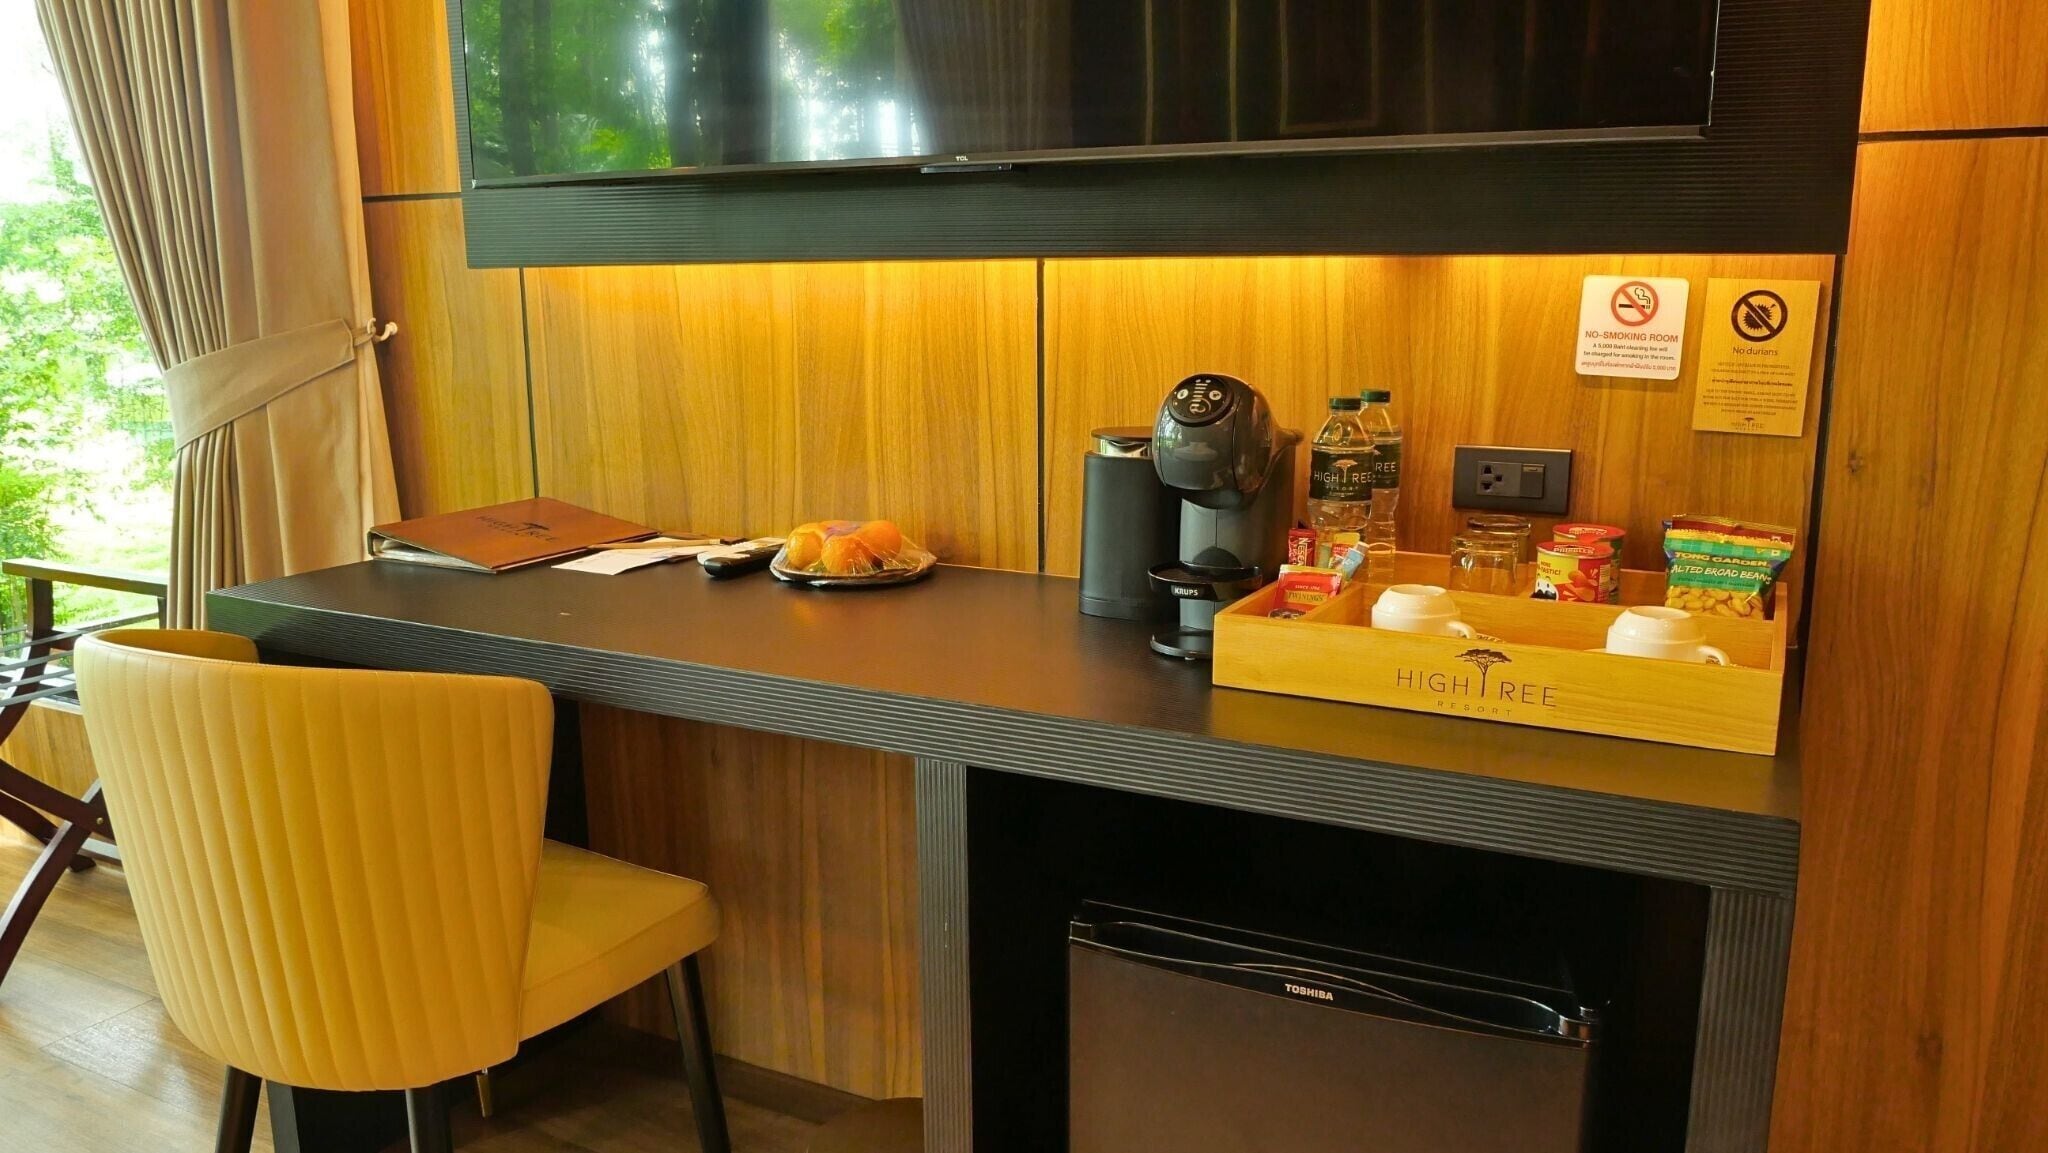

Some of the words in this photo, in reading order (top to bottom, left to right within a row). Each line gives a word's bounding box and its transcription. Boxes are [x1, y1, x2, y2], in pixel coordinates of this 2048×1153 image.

[1585, 331, 1647, 341] NO-SMOKING
[1649, 333, 1678, 343] ROOM
[1621, 352, 1644, 360] smoking
[1732, 346, 1745, 354] No
[1746, 347, 1778, 356] durians
[1313, 470, 1339, 483] HIGH
[1297, 537, 1309, 567] NESCA
[1675, 552, 1710, 561] TONG
[1712, 556, 1768, 567] GARDEN
[1671, 565, 1704, 574] ALTED
[1704, 567, 1739, 577] BROAD
[1740, 570, 1772, 585] BEANS
[1174, 587, 1199, 596] KRUPS
[1397, 668, 1469, 696] HIGH
[1438, 700, 1512, 716] RESORT
[1285, 983, 1334, 1001] TOSHIBA
